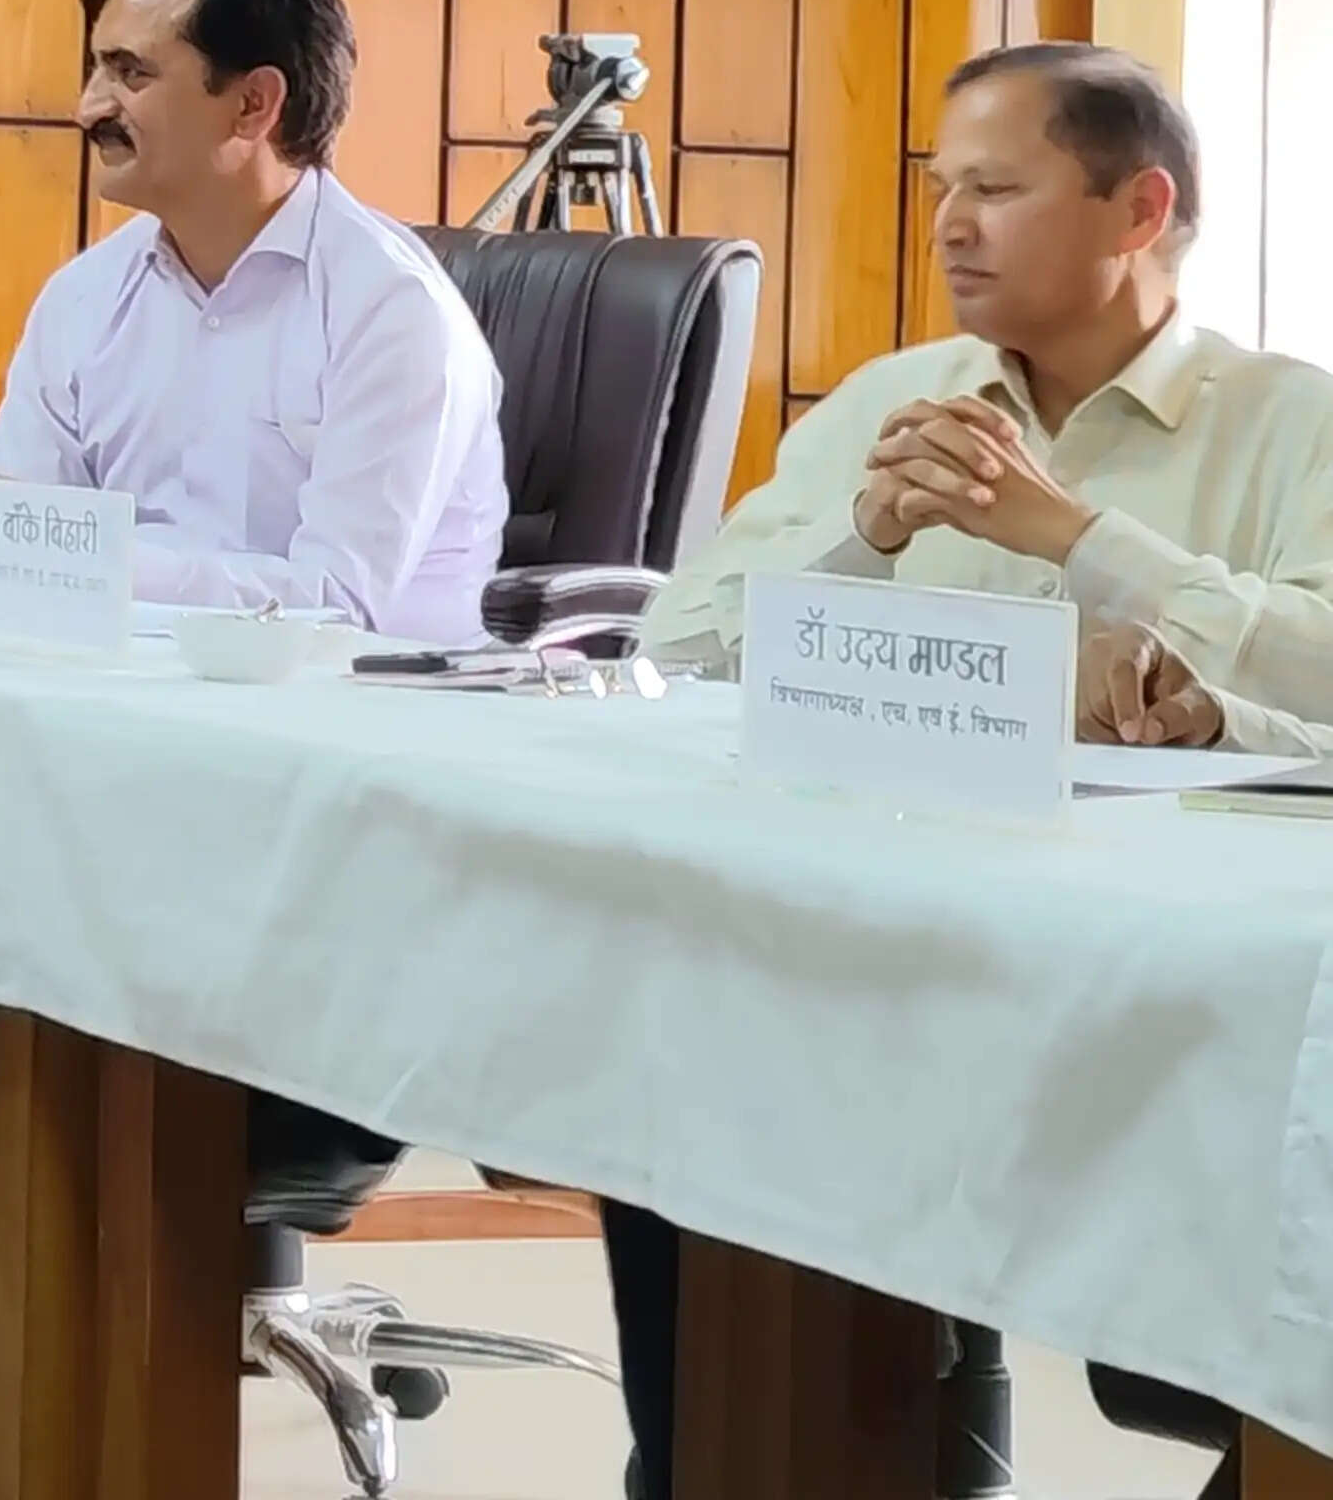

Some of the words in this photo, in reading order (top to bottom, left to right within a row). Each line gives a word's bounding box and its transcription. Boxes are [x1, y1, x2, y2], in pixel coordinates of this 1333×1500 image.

[796, 606, 827, 661] डॉ
[835, 623, 901, 672] उदय
[906, 633, 1009, 686] मण्डल
[970, 704, 1029, 741] विभाग
